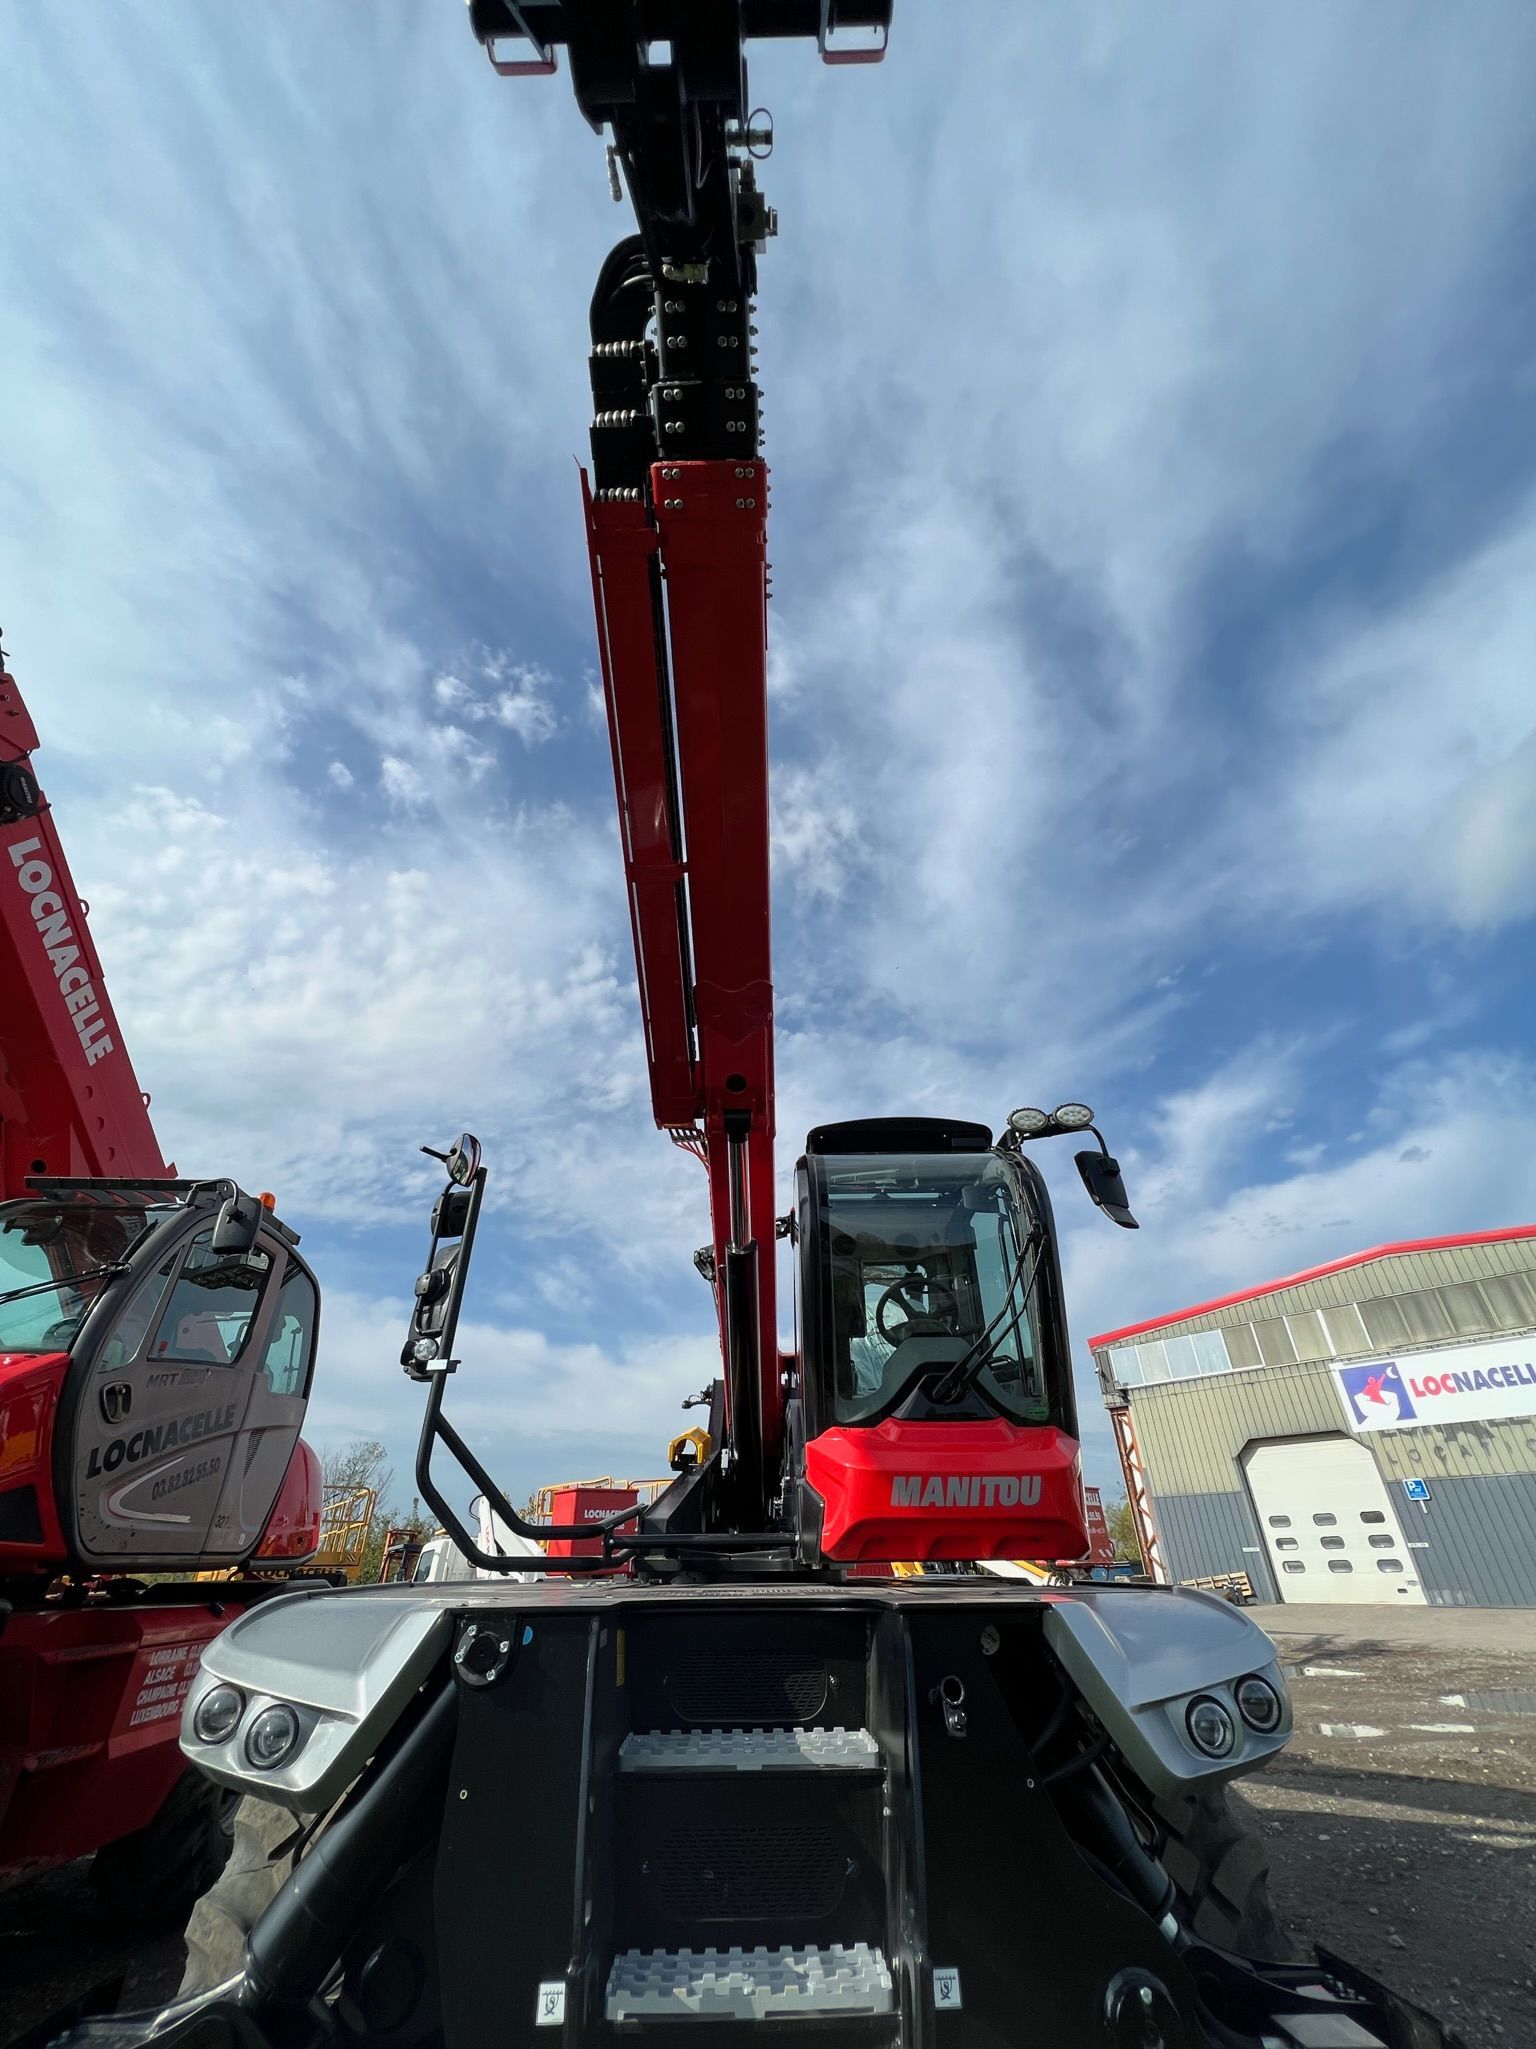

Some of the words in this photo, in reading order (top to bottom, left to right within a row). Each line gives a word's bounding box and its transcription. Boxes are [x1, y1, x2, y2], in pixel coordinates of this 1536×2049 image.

[7, 836, 114, 1067] LOCNACELLE
[85, 1404, 237, 1480] LOCNACELLE
[152, 1457, 221, 1501] 03.82.82.55.50
[890, 1475, 1042, 1507] MANITOU
[143, 1665, 177, 1686] ALSACE
[149, 1646, 189, 1667] LORRAINE
